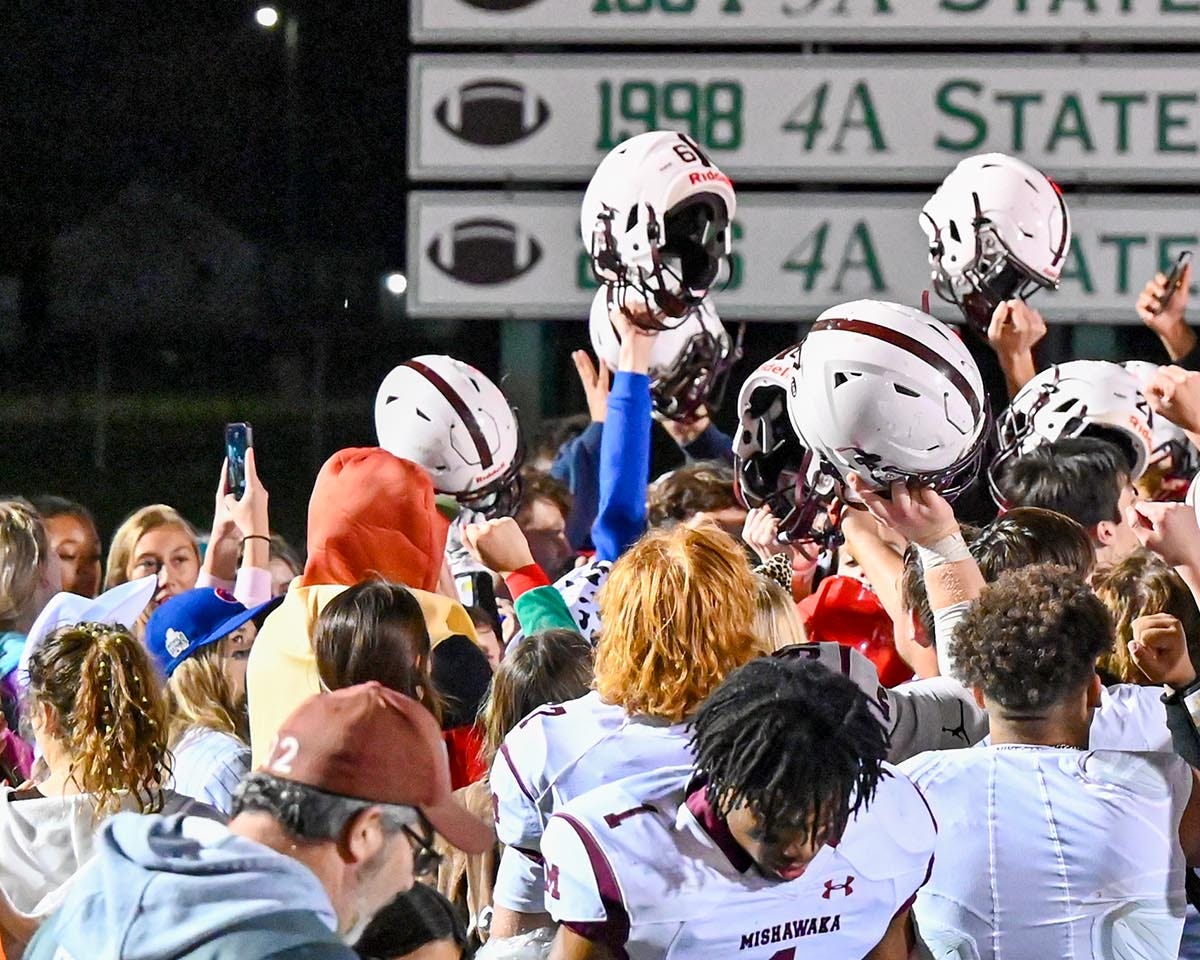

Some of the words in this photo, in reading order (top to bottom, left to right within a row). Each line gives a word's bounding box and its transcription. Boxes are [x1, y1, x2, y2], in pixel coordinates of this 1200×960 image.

[596, 80, 745, 152] 1998
[780, 79, 888, 153] 4A
[933, 78, 1200, 154] STATE
[780, 217, 888, 292] 4A
[1062, 234, 1200, 295] ATE
[739, 914, 841, 951] MISHAWAKA
